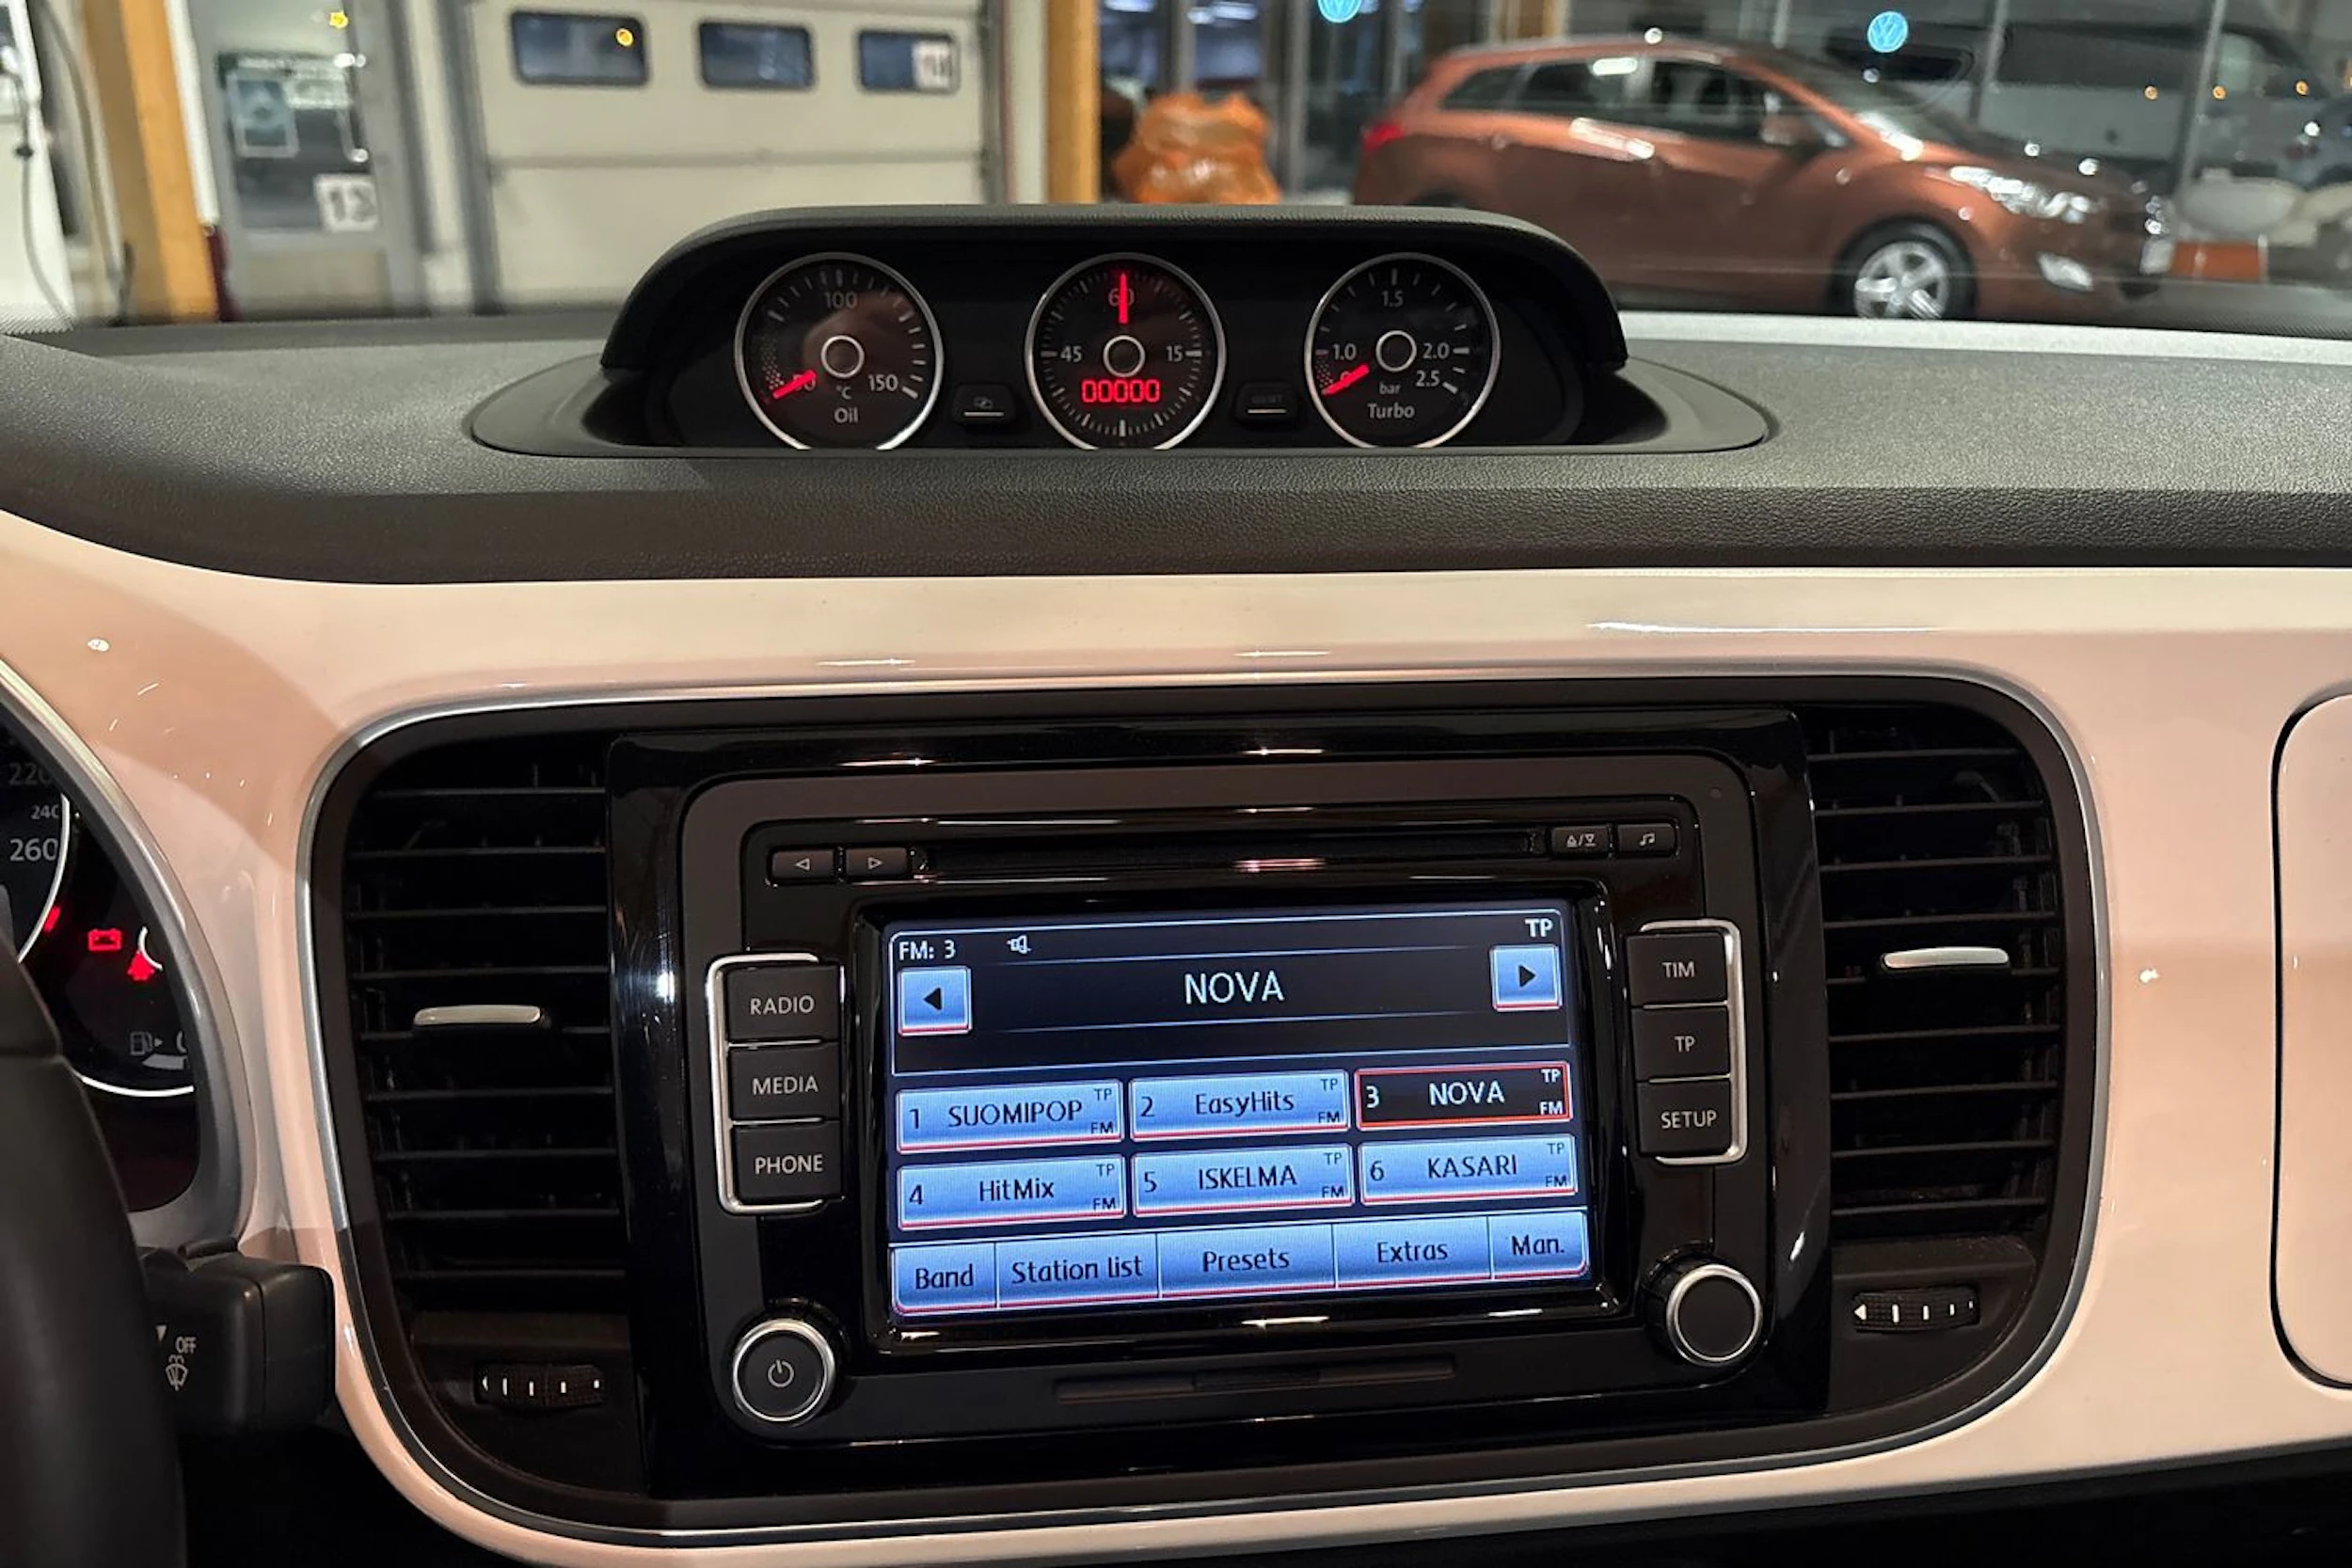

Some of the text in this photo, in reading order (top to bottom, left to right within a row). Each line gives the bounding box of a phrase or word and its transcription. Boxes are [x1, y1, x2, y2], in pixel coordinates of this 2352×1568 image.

[824, 292, 858, 309] 100
[1381, 290, 1404, 308] 1.5
[1060, 345, 1082, 362] 45
[1166, 345, 1184, 362] 15
[1332, 343, 1357, 360] 1.0
[1422, 342, 1450, 359] 2.0
[867, 373, 898, 391] 150
[1415, 370, 1440, 387] 2.5
[1082, 379, 1161, 403] 00000
[1379, 381, 1400, 395] bar
[834, 407, 859, 423] Oil
[1367, 403, 1415, 419] Turbo
[9, 837, 58, 862] 260
[1524, 918, 1553, 938] TP
[898, 940, 956, 960] FM: 3
[1661, 961, 1695, 978] TIM
[1184, 970, 1285, 1005] NOVA
[750, 995, 816, 1015] RADIO
[1674, 1036, 1695, 1053] TP
[1541, 1069, 1562, 1083] TP
[753, 1076, 818, 1095] MEDIA
[1320, 1079, 1338, 1091] TP
[1094, 1088, 1112, 1101] TP
[1366, 1081, 1505, 1108] 3 NOVA
[1140, 1091, 1295, 1117] 2 EasyHits
[1539, 1101, 1563, 1115] FM
[910, 1101, 1082, 1129] 1 SUOMIPOP
[1318, 1111, 1340, 1124] FM
[1661, 1110, 1717, 1129] SETUP
[1091, 1122, 1114, 1134] FM
[1547, 1143, 1565, 1155] TP
[755, 1154, 822, 1175] PHONE
[1324, 1152, 1342, 1165] TP
[1096, 1164, 1115, 1177] TP
[1370, 1154, 1517, 1181] 6 KASARI
[1144, 1165, 1297, 1193] 5 ISKELMA
[1546, 1176, 1566, 1188] FM
[909, 1178, 1055, 1205] 4 HitMix
[1322, 1186, 1343, 1198] FM
[1093, 1197, 1116, 1210] FM
[1377, 1239, 1449, 1264] Extras
[1512, 1234, 1565, 1258] Man.
[1203, 1247, 1290, 1273] Presets
[915, 1263, 974, 1290] Band
[1012, 1256, 1143, 1284] Station list
[175, 1337, 197, 1354] OFF
